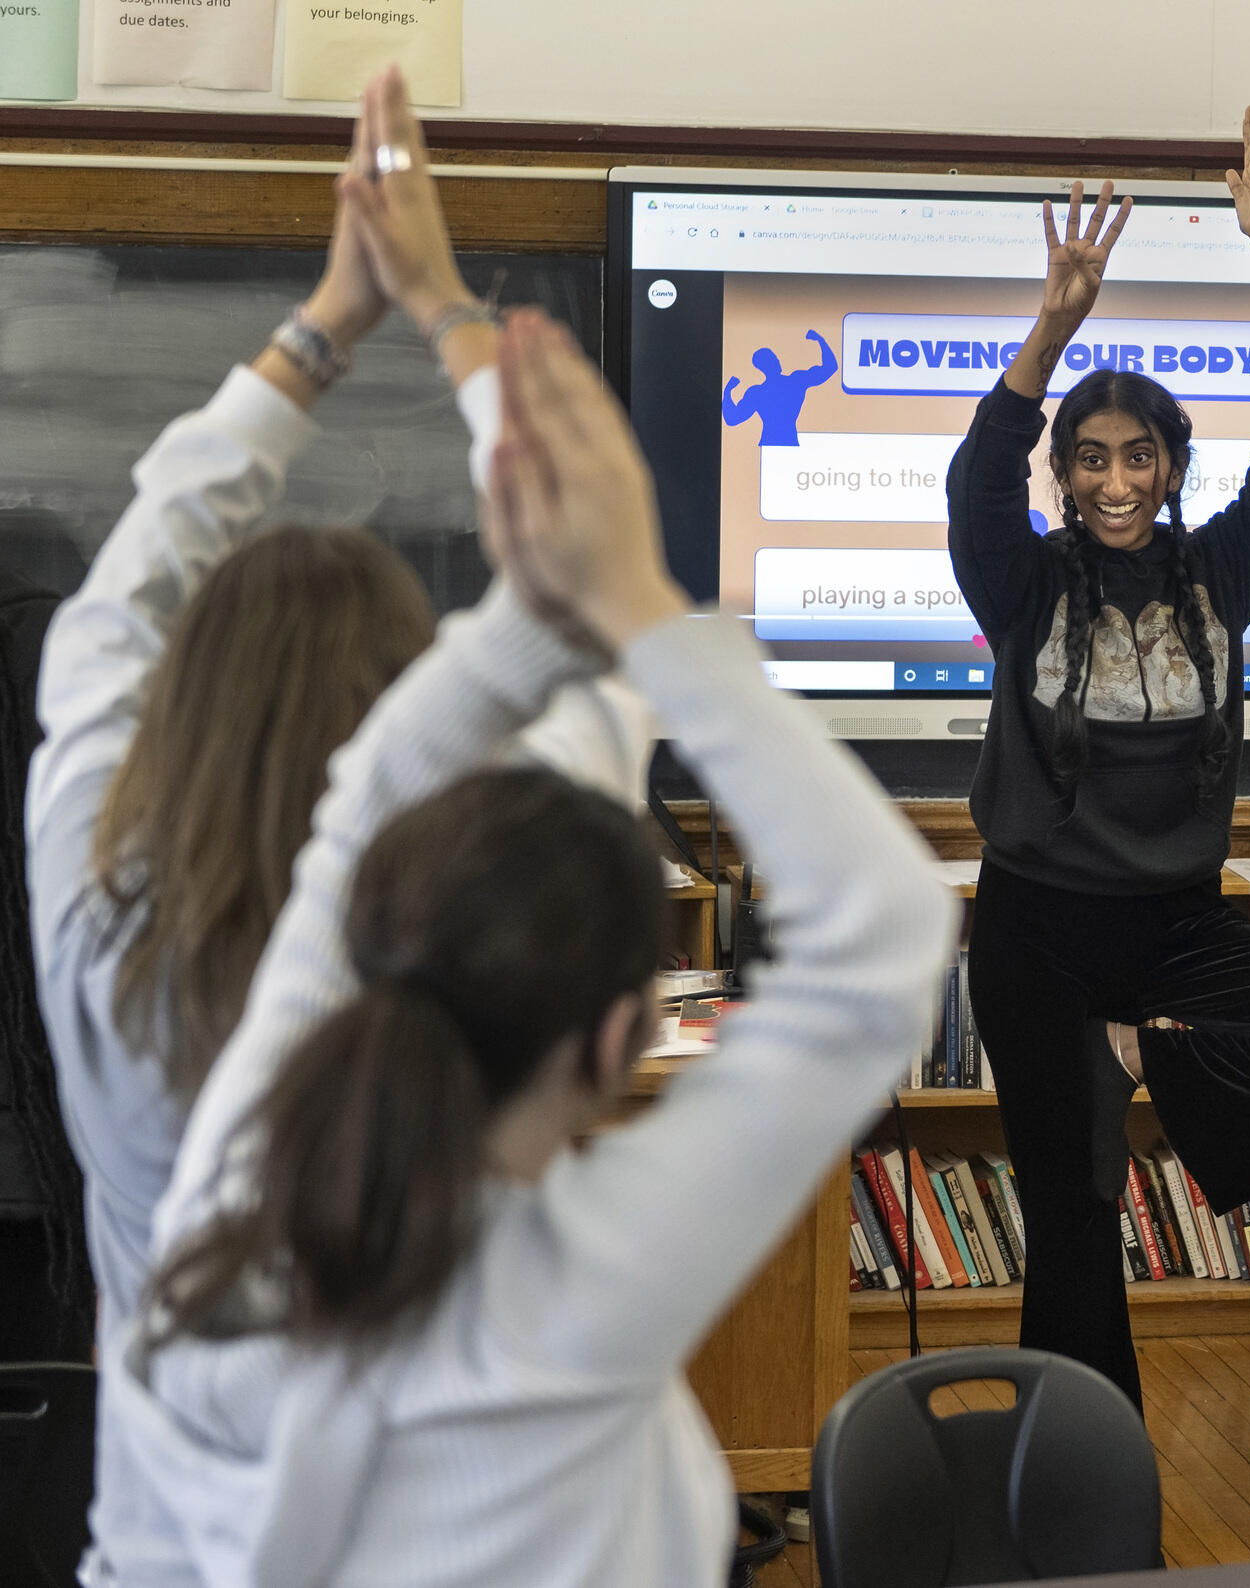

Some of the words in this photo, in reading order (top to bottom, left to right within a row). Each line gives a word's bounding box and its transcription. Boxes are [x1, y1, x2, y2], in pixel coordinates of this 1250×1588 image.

[0, 5, 41, 16] yours.
[119, 14, 145, 26] due
[148, 15, 189, 28] dates.
[310, 8, 341, 19] your
[344, 8, 419, 25] belongings.
[651, 289, 674, 298] Canva
[796, 467, 862, 491] going
[869, 468, 892, 487] to
[900, 468, 937, 487] the
[1189, 476, 1211, 492] or
[801, 585, 886, 609] playing
[893, 589, 906, 605] a
[992, 1226, 1015, 1275] SEABISCUIT
[1140, 1216, 1153, 1247] MICHAEL
[1148, 1247, 1159, 1268] LEWIS
[1151, 1221, 1171, 1270] SEABISCUIT
